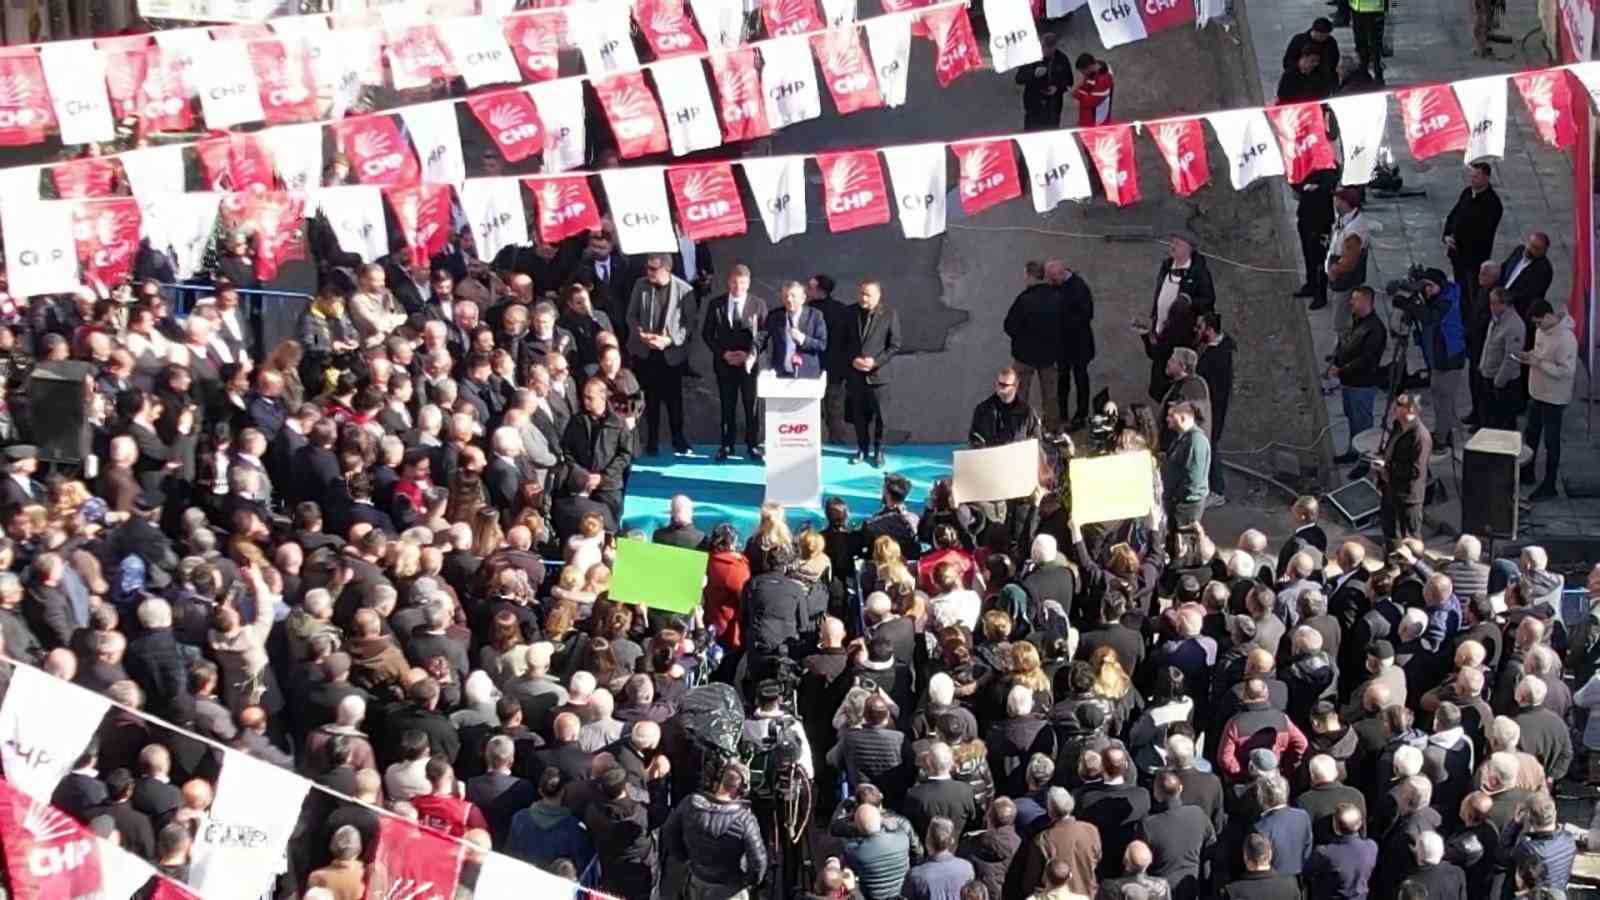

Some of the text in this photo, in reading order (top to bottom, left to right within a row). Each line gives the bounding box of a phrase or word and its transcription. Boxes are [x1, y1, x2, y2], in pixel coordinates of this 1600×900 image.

[1101, 4, 1133, 23] CHP
[994, 29, 1028, 49] CHP
[770, 80, 804, 101] CHP
[498, 122, 539, 145] CHP
[1409, 114, 1451, 139] CHP
[686, 199, 731, 222] CHP
[831, 190, 874, 214] CHP
[623, 210, 661, 228] CHP
[777, 423, 809, 434] CHP
[28, 838, 95, 878] CHP
